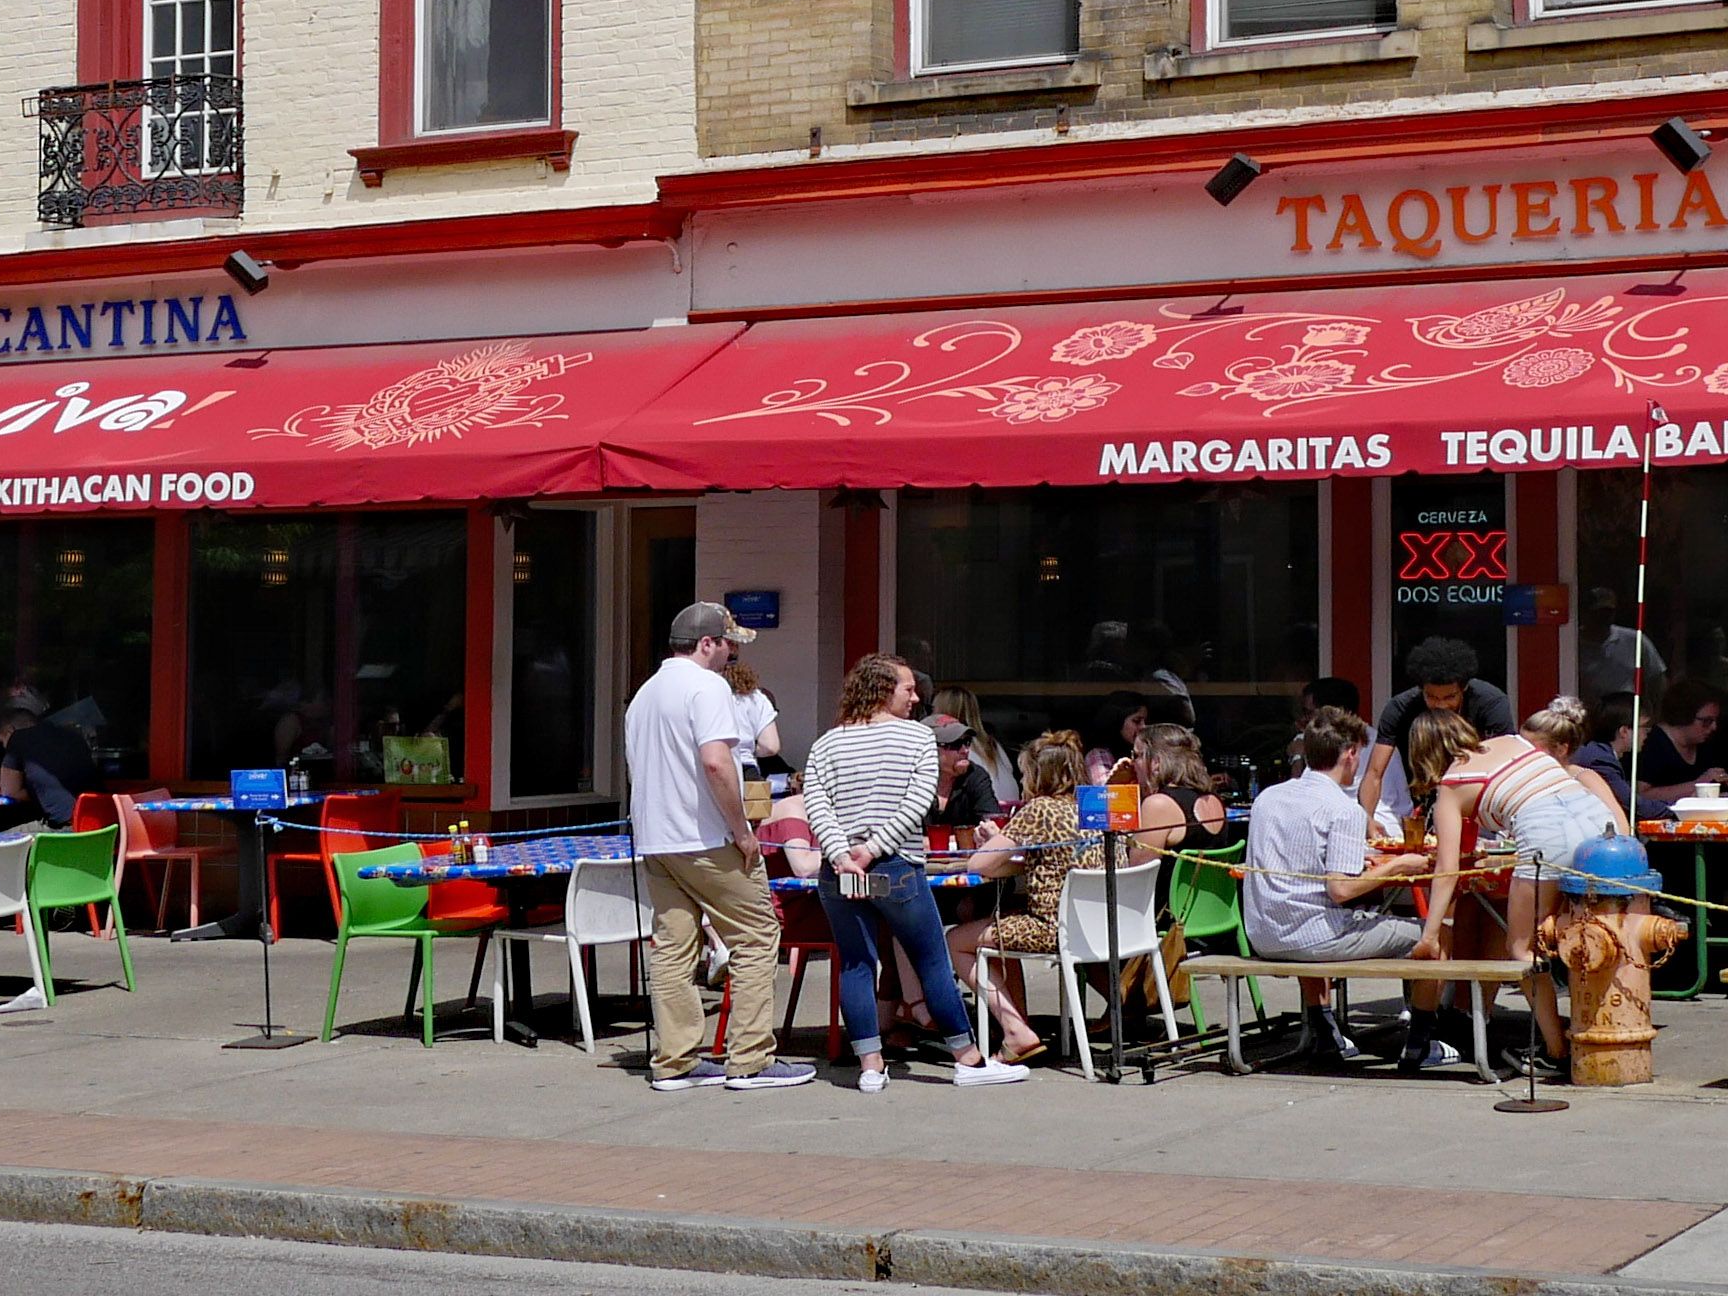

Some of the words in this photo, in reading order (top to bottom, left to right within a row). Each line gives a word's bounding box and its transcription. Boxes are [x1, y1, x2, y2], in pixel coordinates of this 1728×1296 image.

[1098, 433, 1392, 476] MARGARITAS
[1440, 424, 1640, 466] TEQUILA
[160, 471, 255, 502] FOOD
[1417, 510, 1488, 525] CERVEZA
[1399, 531, 1508, 579] XX
[1397, 585, 1440, 604] DOS
[1446, 584, 1504, 604] EQUIS
